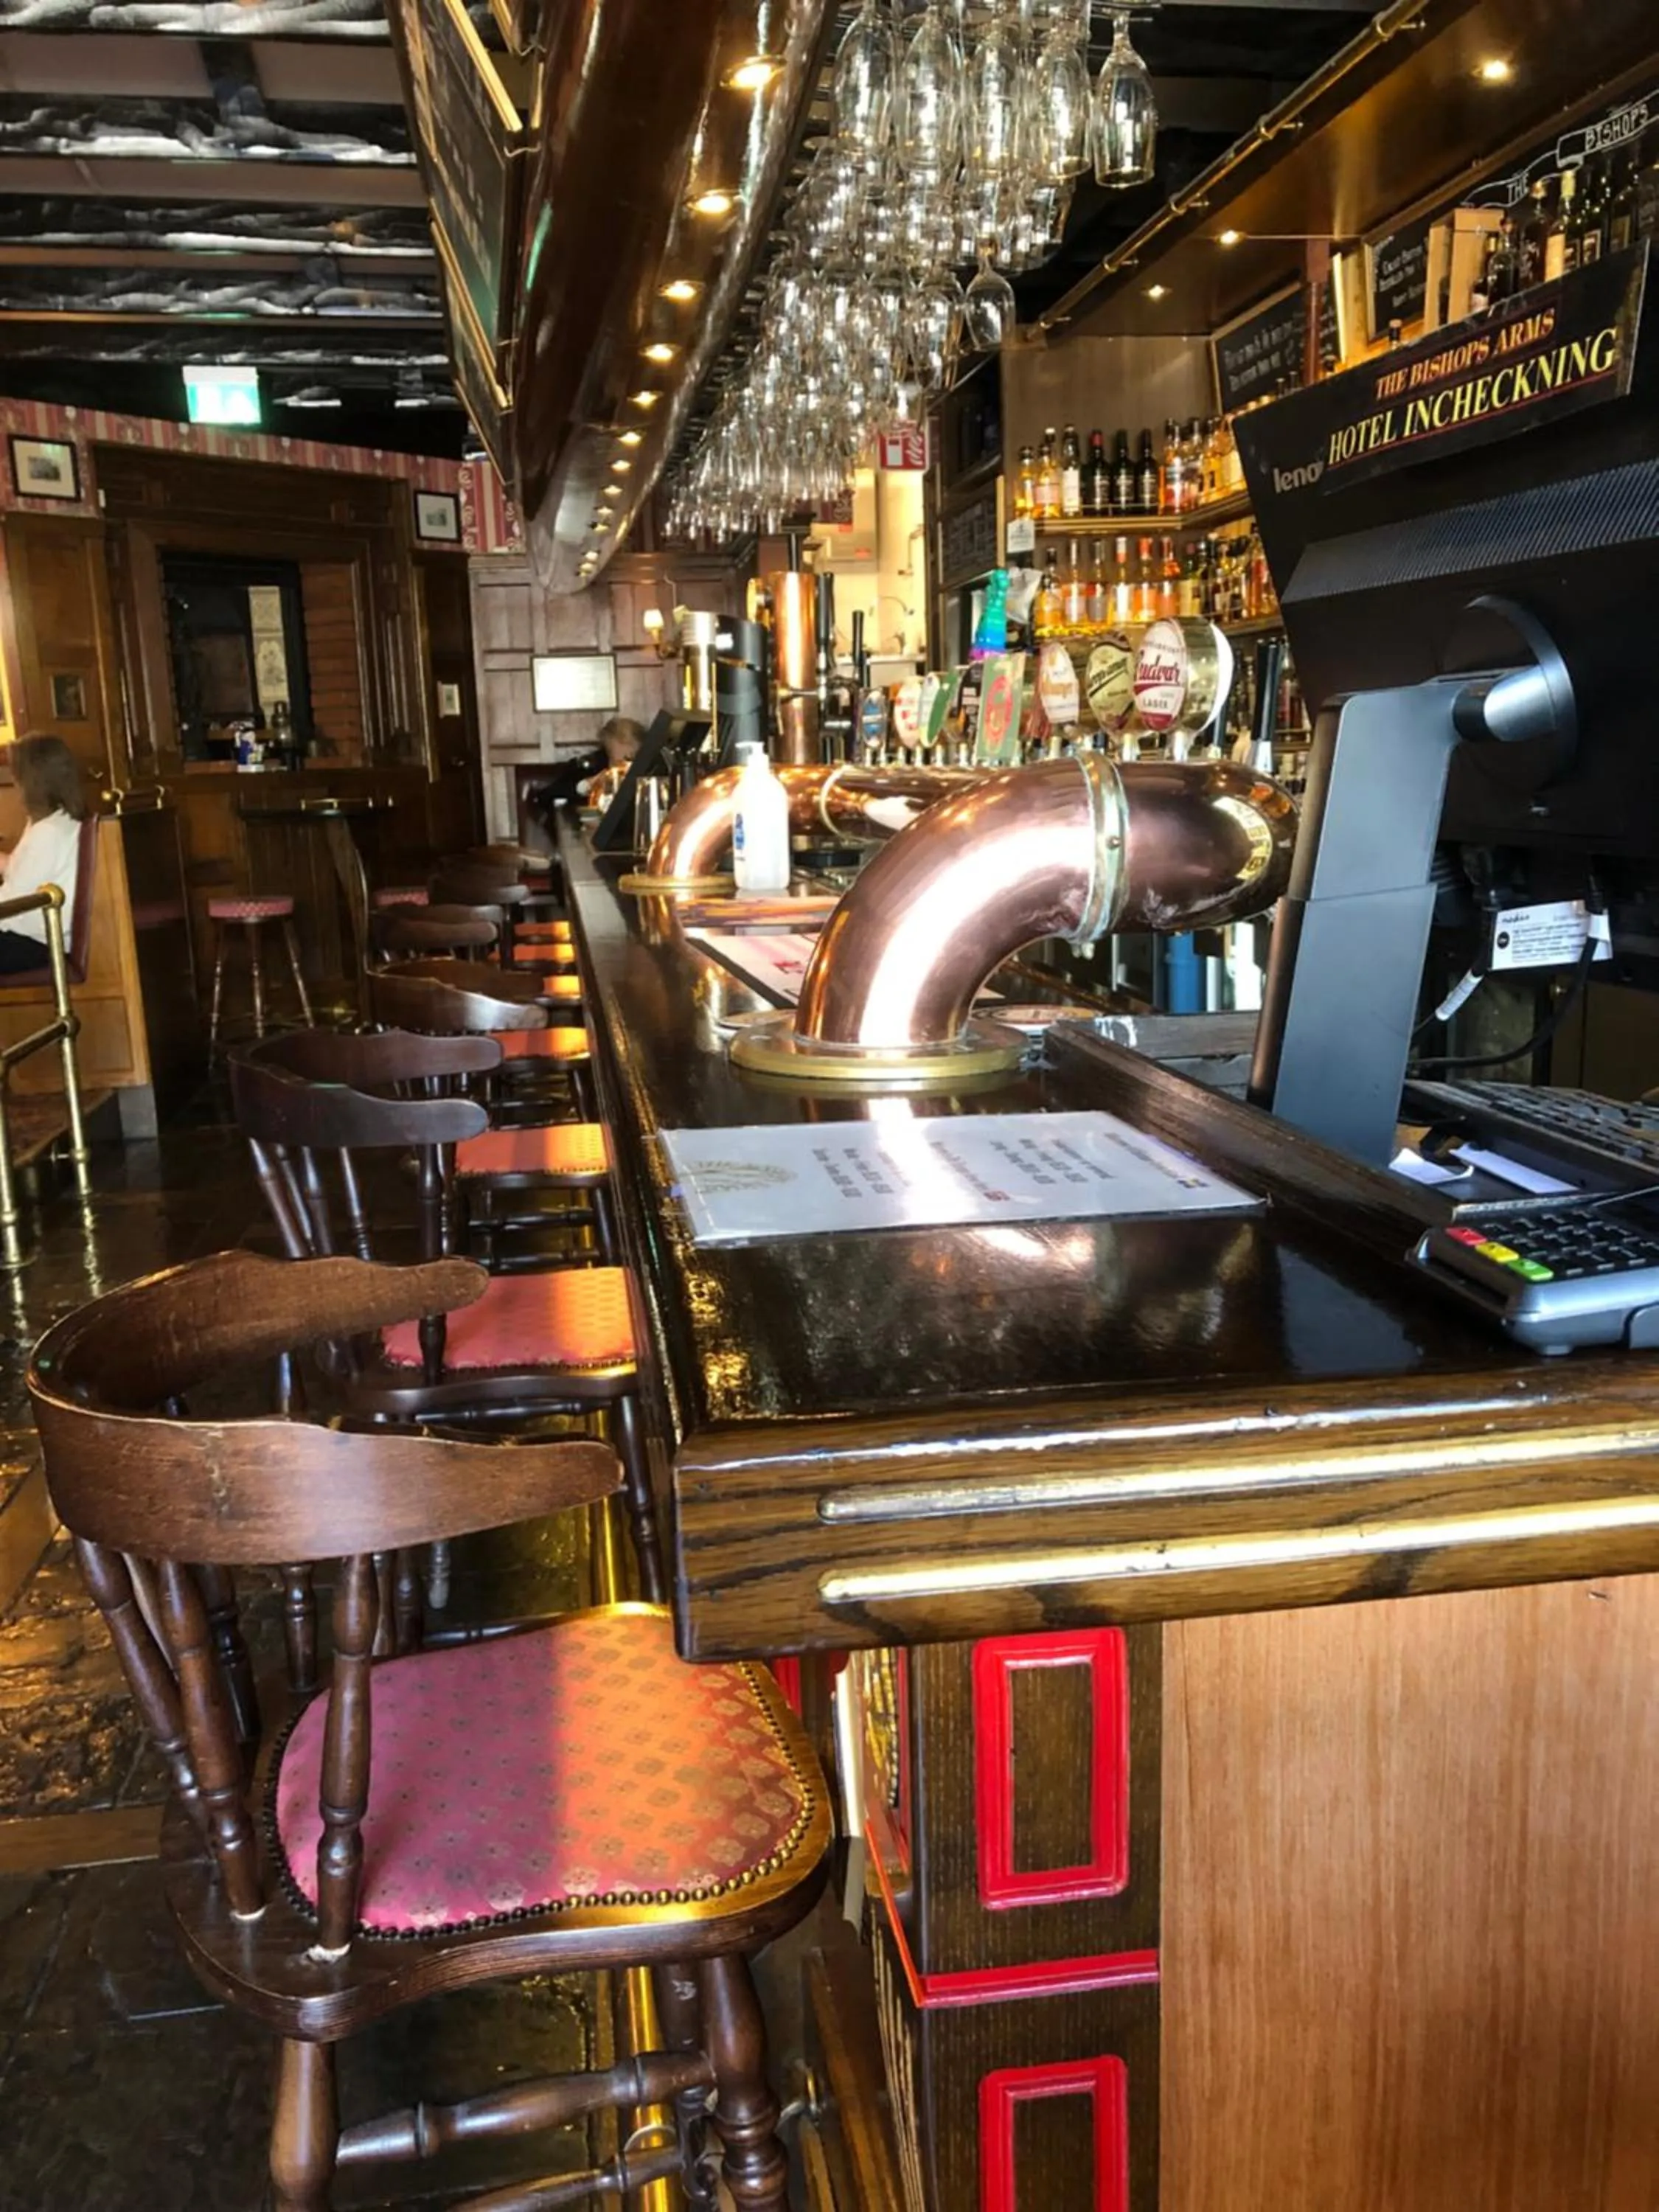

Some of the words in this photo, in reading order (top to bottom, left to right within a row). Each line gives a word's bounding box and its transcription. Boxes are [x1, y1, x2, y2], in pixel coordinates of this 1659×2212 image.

[1507, 172, 1530, 206] THE
[1586, 104, 1649, 151] BISHOPS
[1329, 411, 1397, 465] HOTEL
[1403, 327, 1618, 438] INCHECKNING
[1375, 370, 1407, 400] THE
[1409, 335, 1491, 388] BISHOPS
[1493, 313, 1556, 355] ARMS
